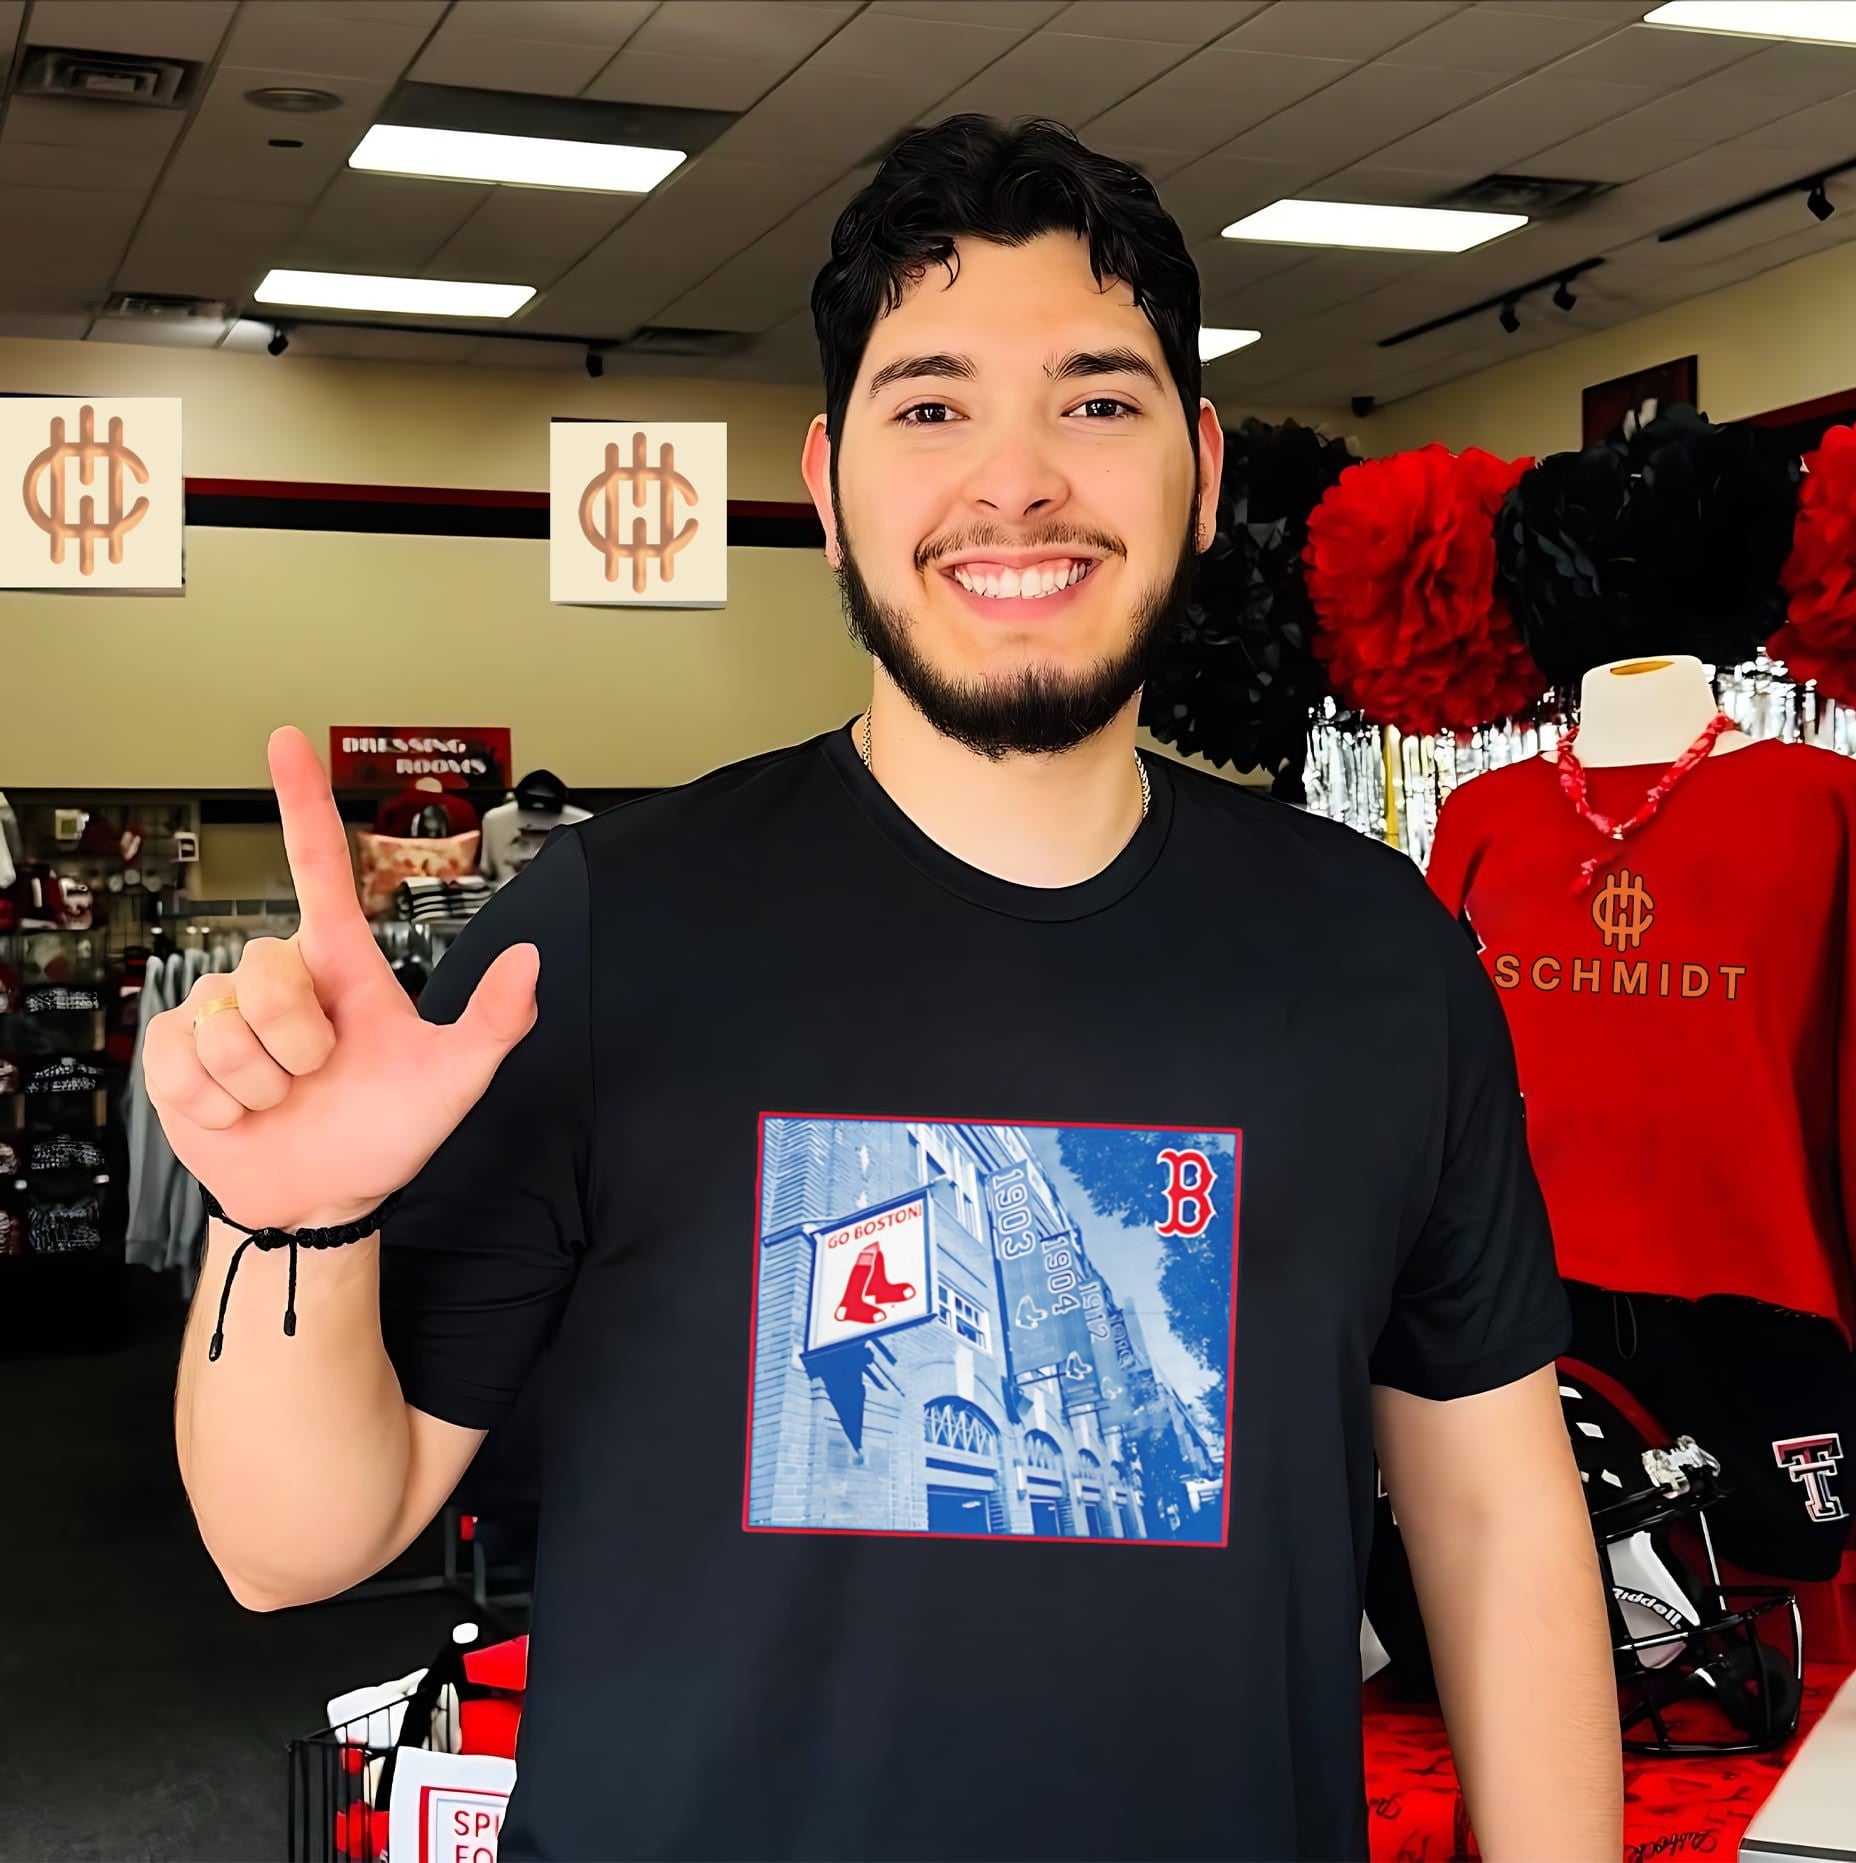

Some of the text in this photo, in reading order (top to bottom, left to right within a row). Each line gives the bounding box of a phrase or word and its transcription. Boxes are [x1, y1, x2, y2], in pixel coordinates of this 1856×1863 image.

[341, 736, 467, 754] DRESSING
[395, 758, 488, 775] ROOMS
[1493, 952, 1747, 1001] SCHMIDT
[991, 1167, 1037, 1261] 1903
[1155, 1147, 1218, 1239] B
[827, 1231, 850, 1249] GO
[1040, 1233, 1081, 1317] 1904
[1077, 1279, 1111, 1345] 1912
